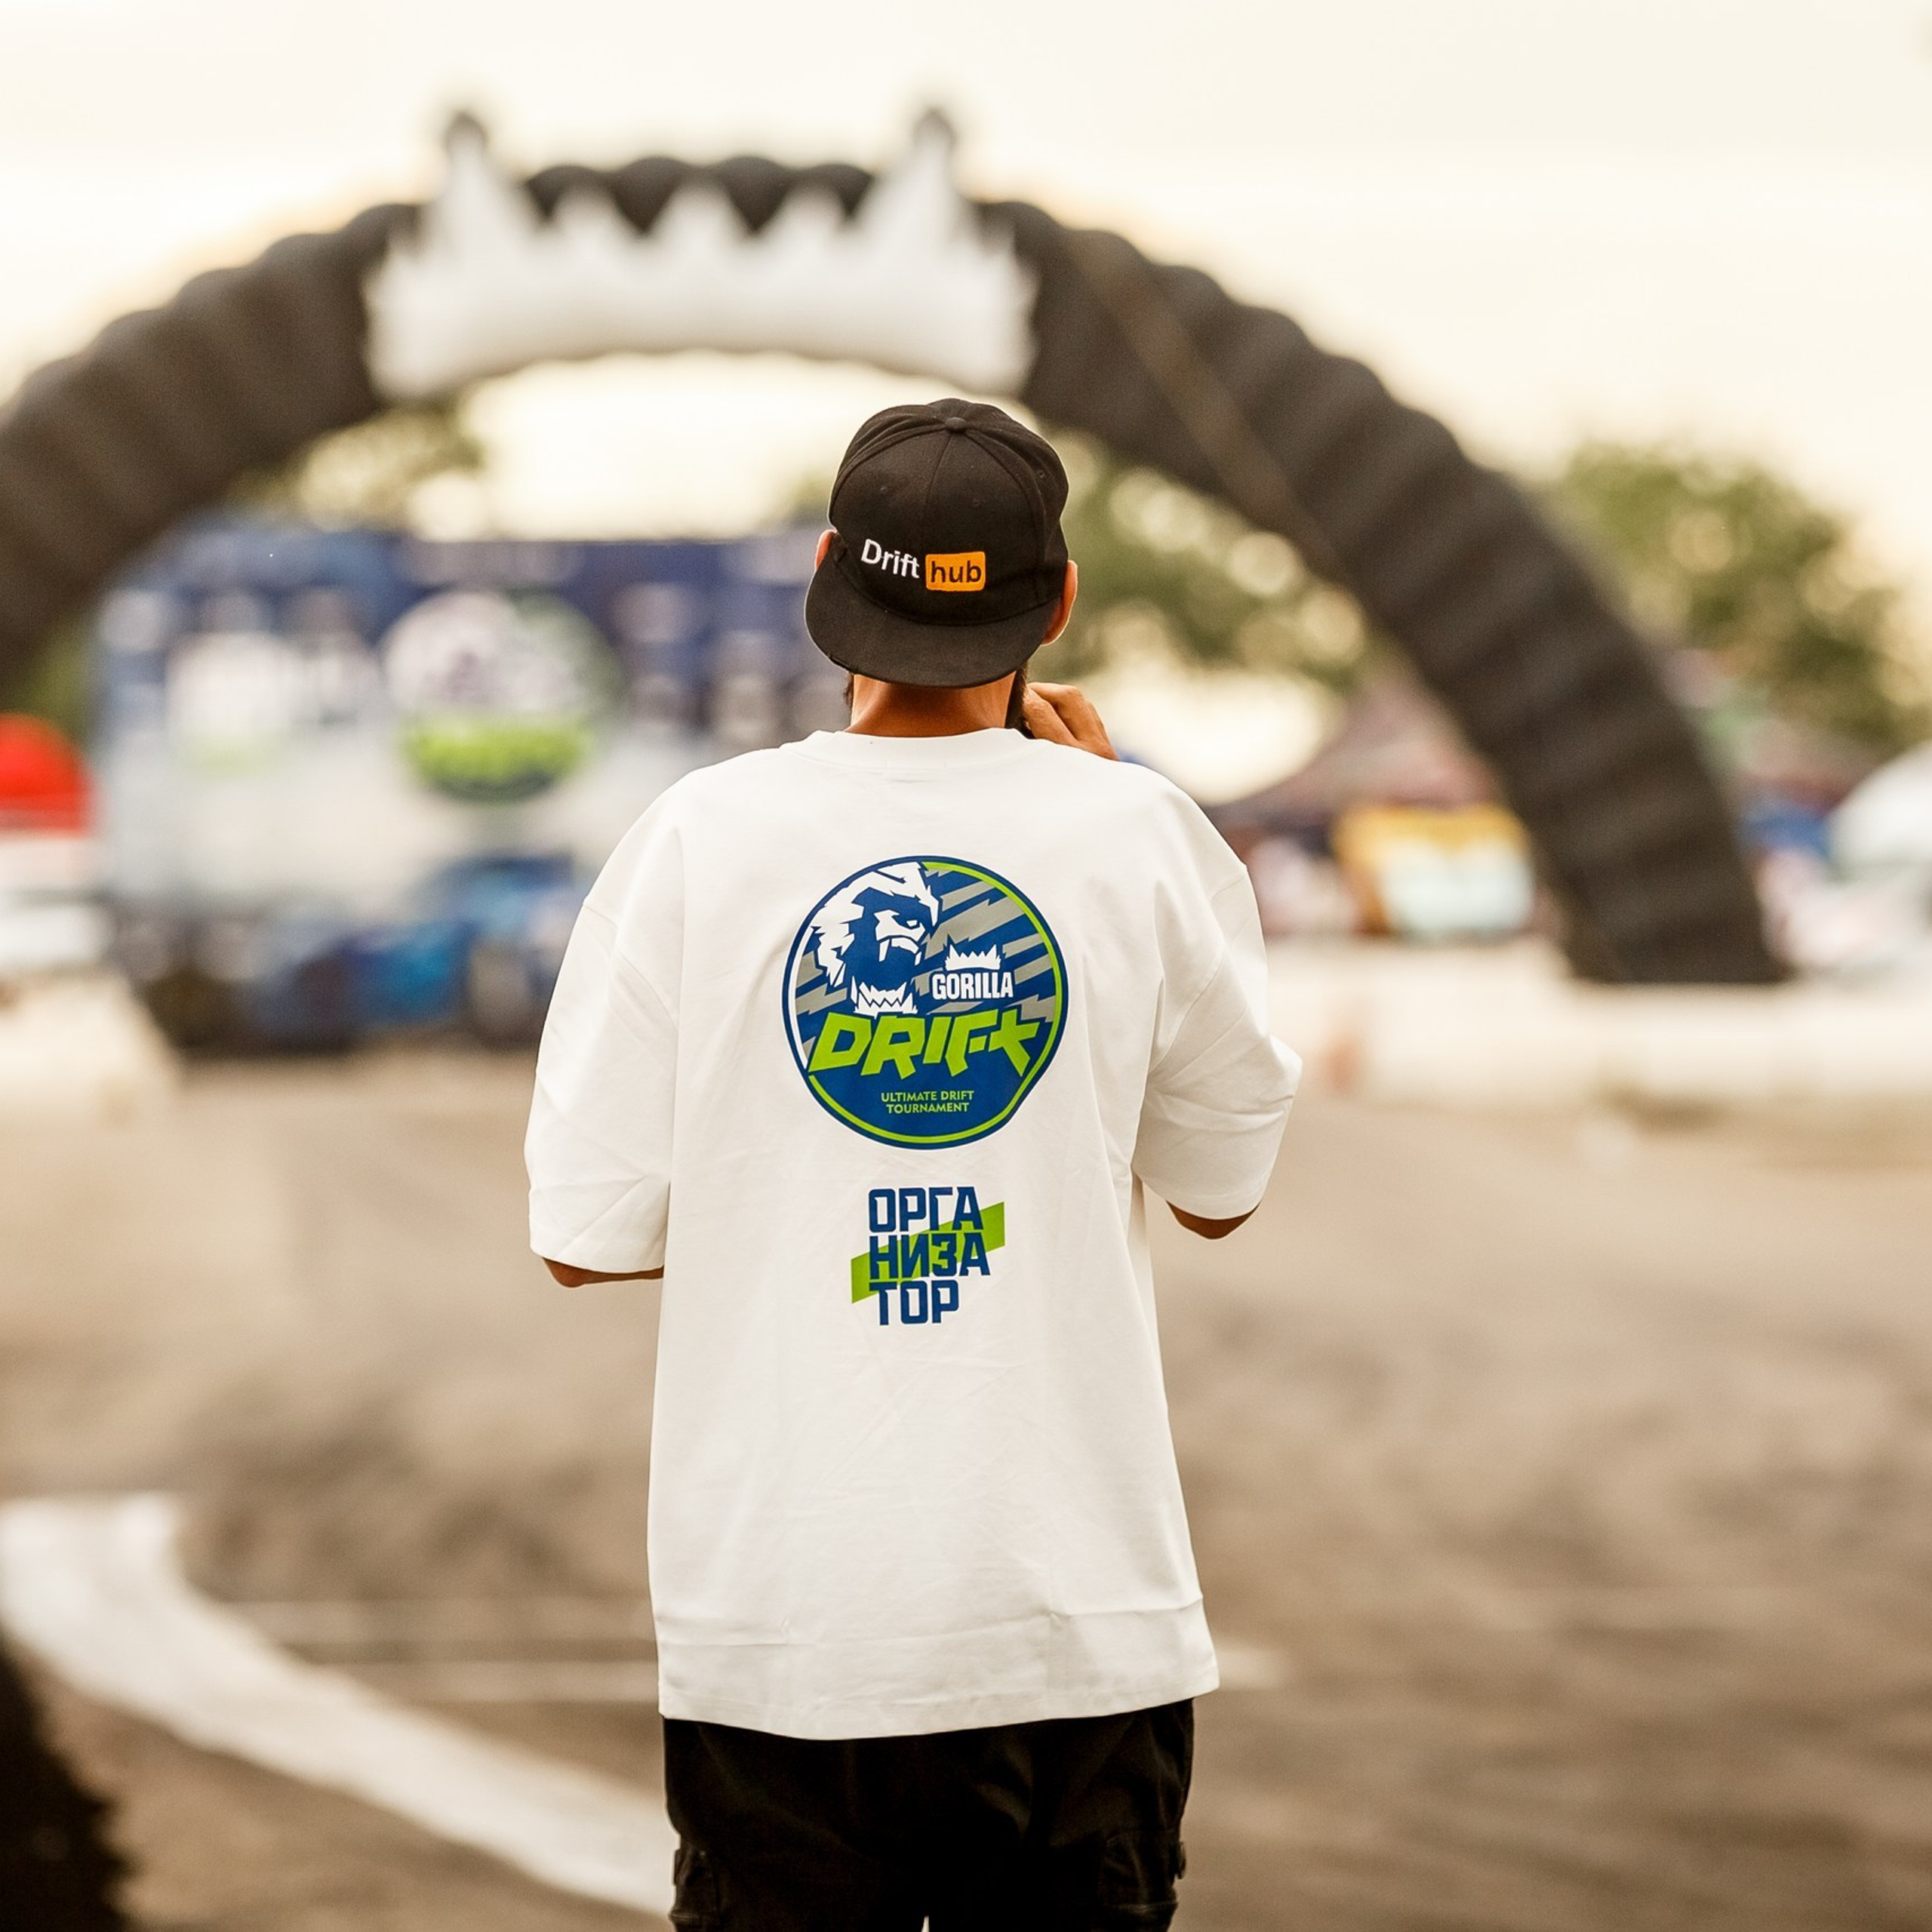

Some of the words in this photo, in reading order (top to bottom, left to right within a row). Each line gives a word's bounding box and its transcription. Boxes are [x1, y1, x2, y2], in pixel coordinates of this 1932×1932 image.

[860, 538, 920, 579] Drift
[931, 560, 982, 583] hub
[931, 971, 1014, 1001] GORILLA
[808, 1008, 1040, 1079] DRIFT
[881, 1091, 937, 1103] ULTIMATE
[940, 1090, 975, 1100] DRIFT
[885, 1102, 970, 1114] TOURNAMENT
[868, 1186, 984, 1232] ОРГА
[869, 1232, 991, 1280] НИЗА
[869, 1279, 959, 1326] ТОР
